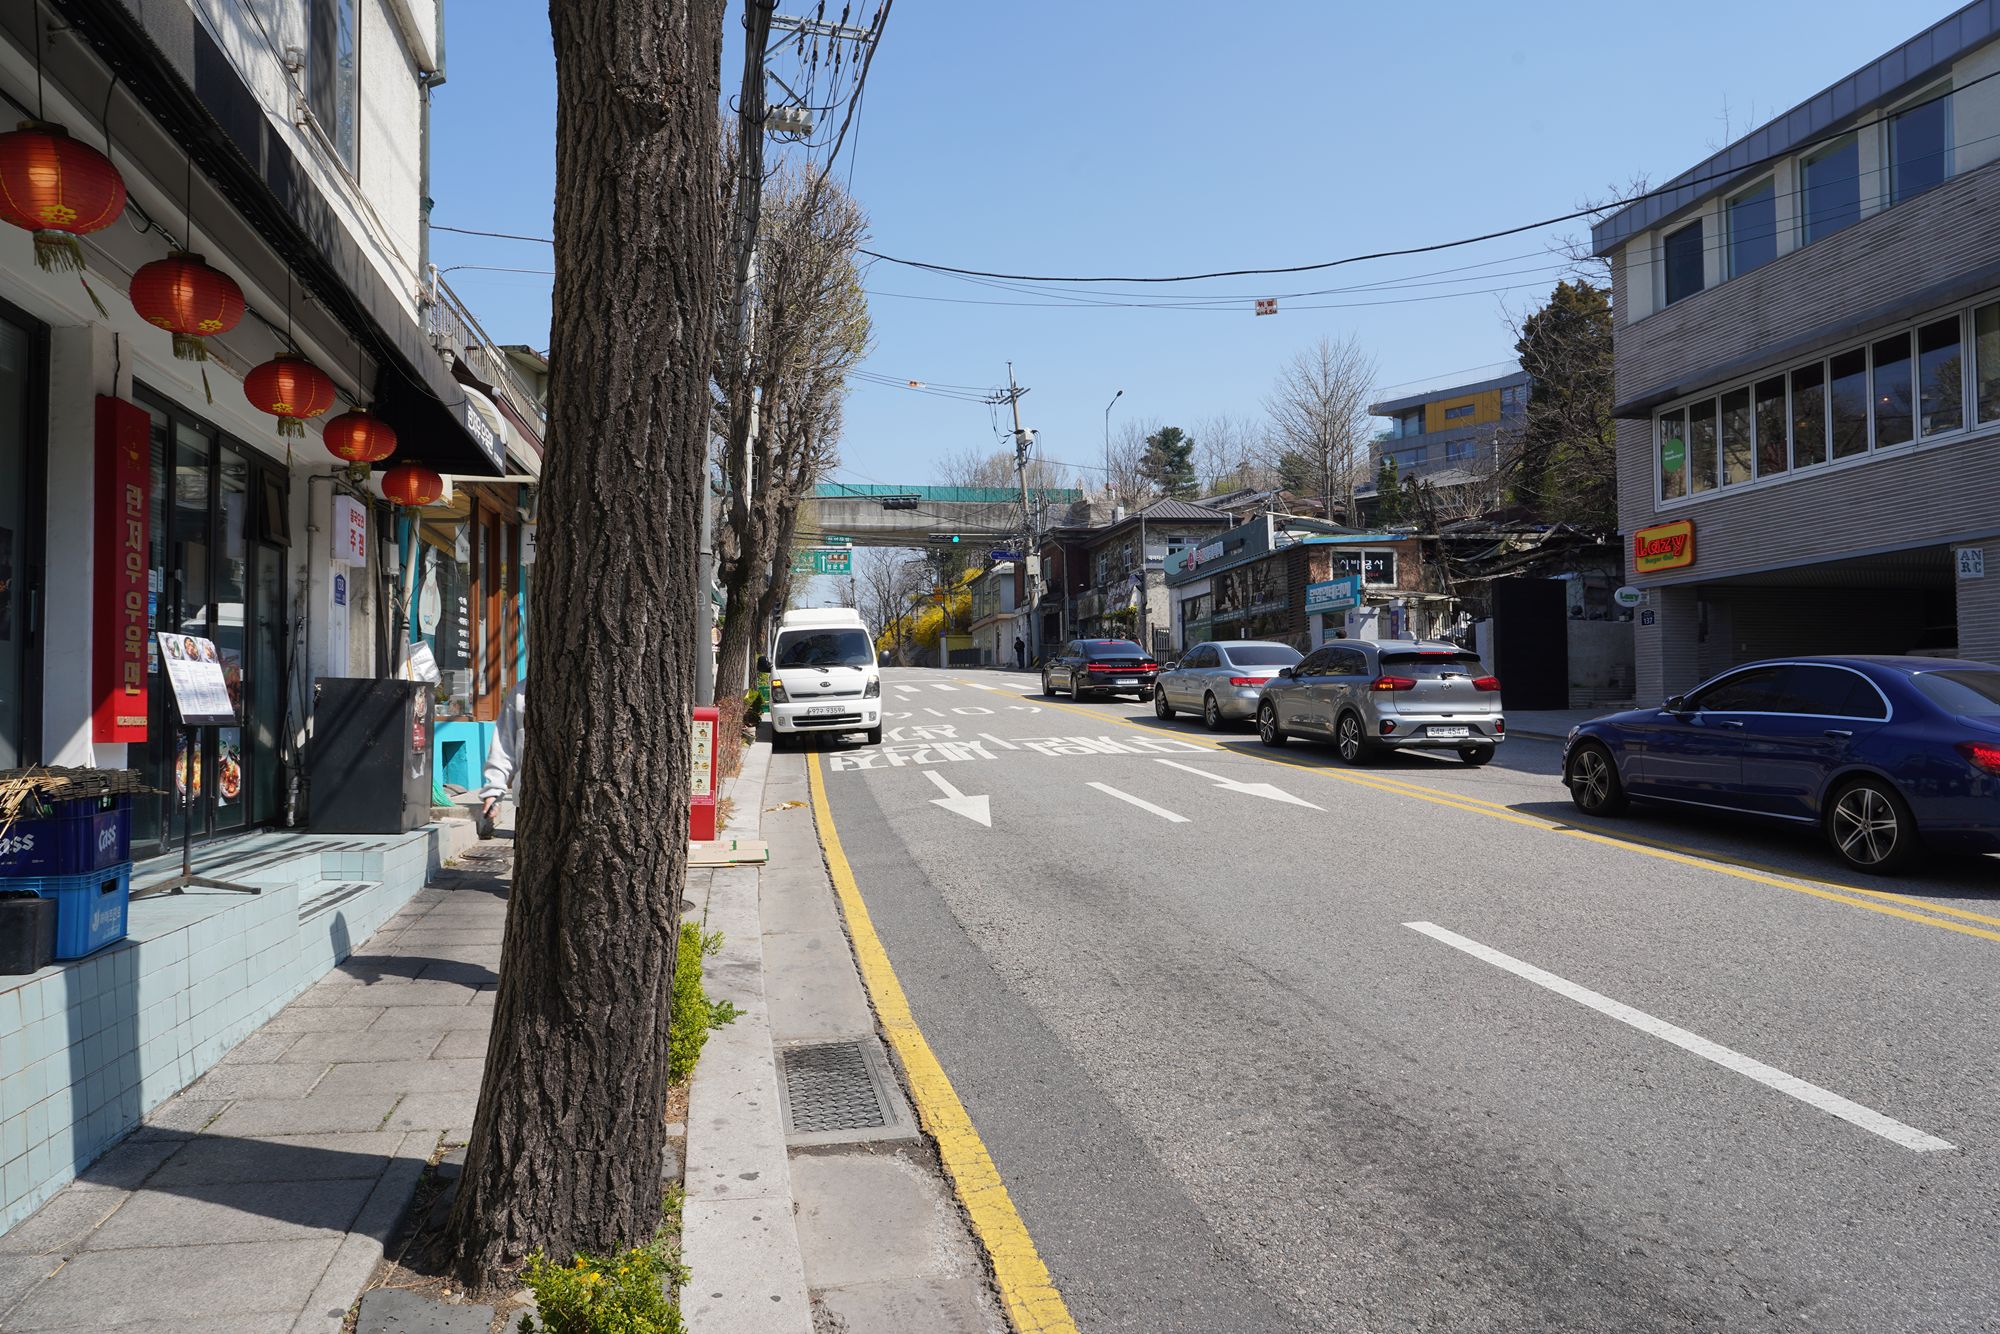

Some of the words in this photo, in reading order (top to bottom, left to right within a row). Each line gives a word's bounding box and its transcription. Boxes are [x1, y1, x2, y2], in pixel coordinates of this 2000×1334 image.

[1635, 533, 1688, 557] Lazy
[1960, 550, 1982, 561] AN
[1643, 617, 1653, 625] 137
[829, 740, 998, 771] 세검정
[0, 833, 35, 857] ass
[98, 824, 117, 852] Cass
